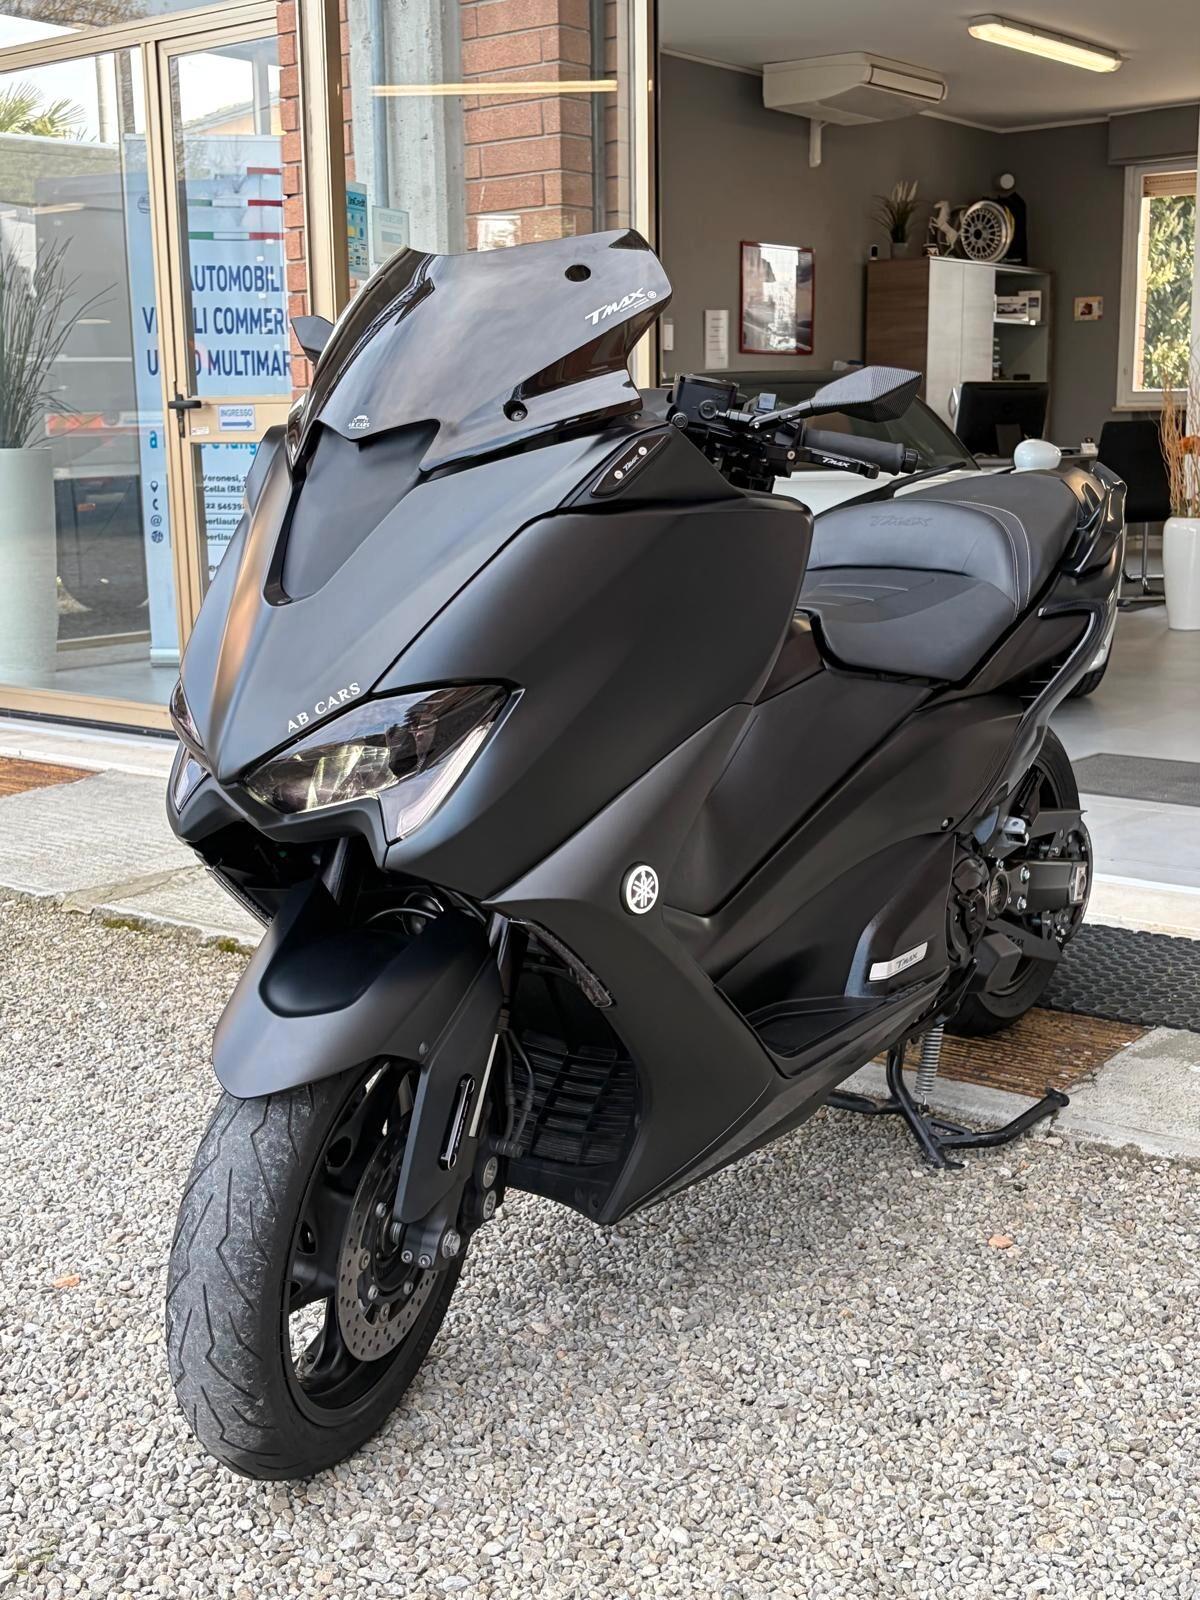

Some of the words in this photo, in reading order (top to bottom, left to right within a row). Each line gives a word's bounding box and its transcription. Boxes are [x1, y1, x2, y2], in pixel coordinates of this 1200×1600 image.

[191, 265, 284, 292] UTOMOBILI
[584, 287, 646, 326] TMAX
[213, 307, 288, 335] COMMER
[208, 350, 291, 376] MULTIMAR
[220, 408, 253, 417] INGRESSO
[822, 456, 850, 468] TMAX
[287, 712, 310, 733] AB
[314, 682, 361, 715] CARS
